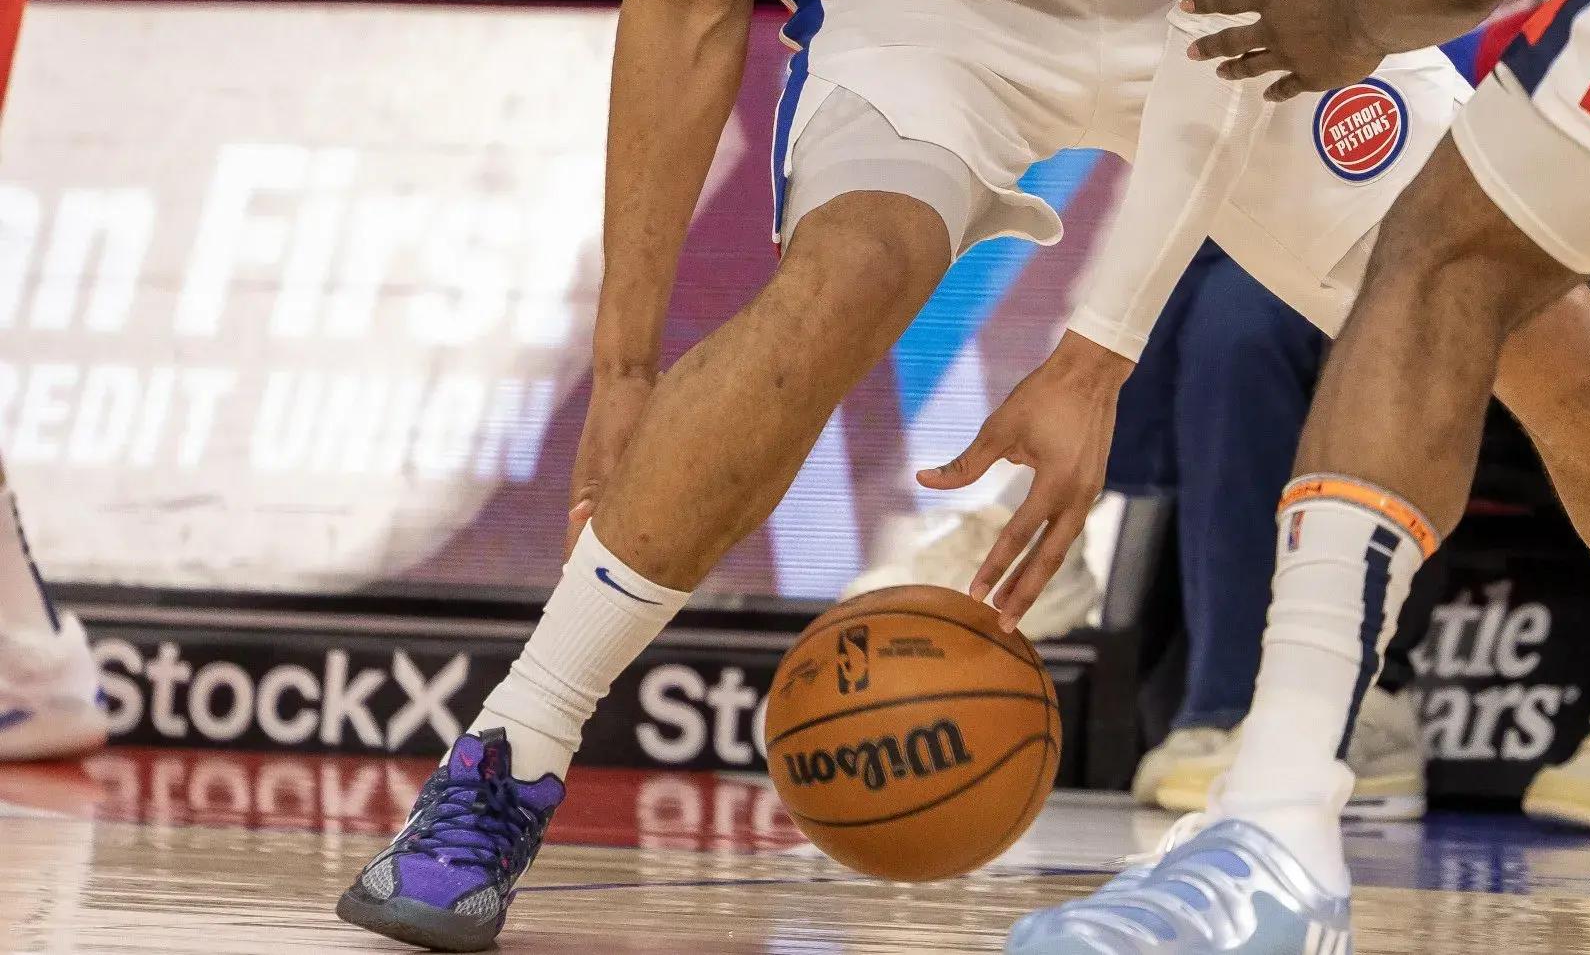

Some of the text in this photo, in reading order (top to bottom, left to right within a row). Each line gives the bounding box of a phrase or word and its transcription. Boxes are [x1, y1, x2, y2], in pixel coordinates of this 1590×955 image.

[1328, 100, 1384, 143] DETROIT
[1335, 114, 1391, 157] PISTONS
[174, 143, 606, 348] First
[97, 638, 468, 749] StockX
[636, 662, 768, 764] St
[784, 717, 972, 791] Wilson
